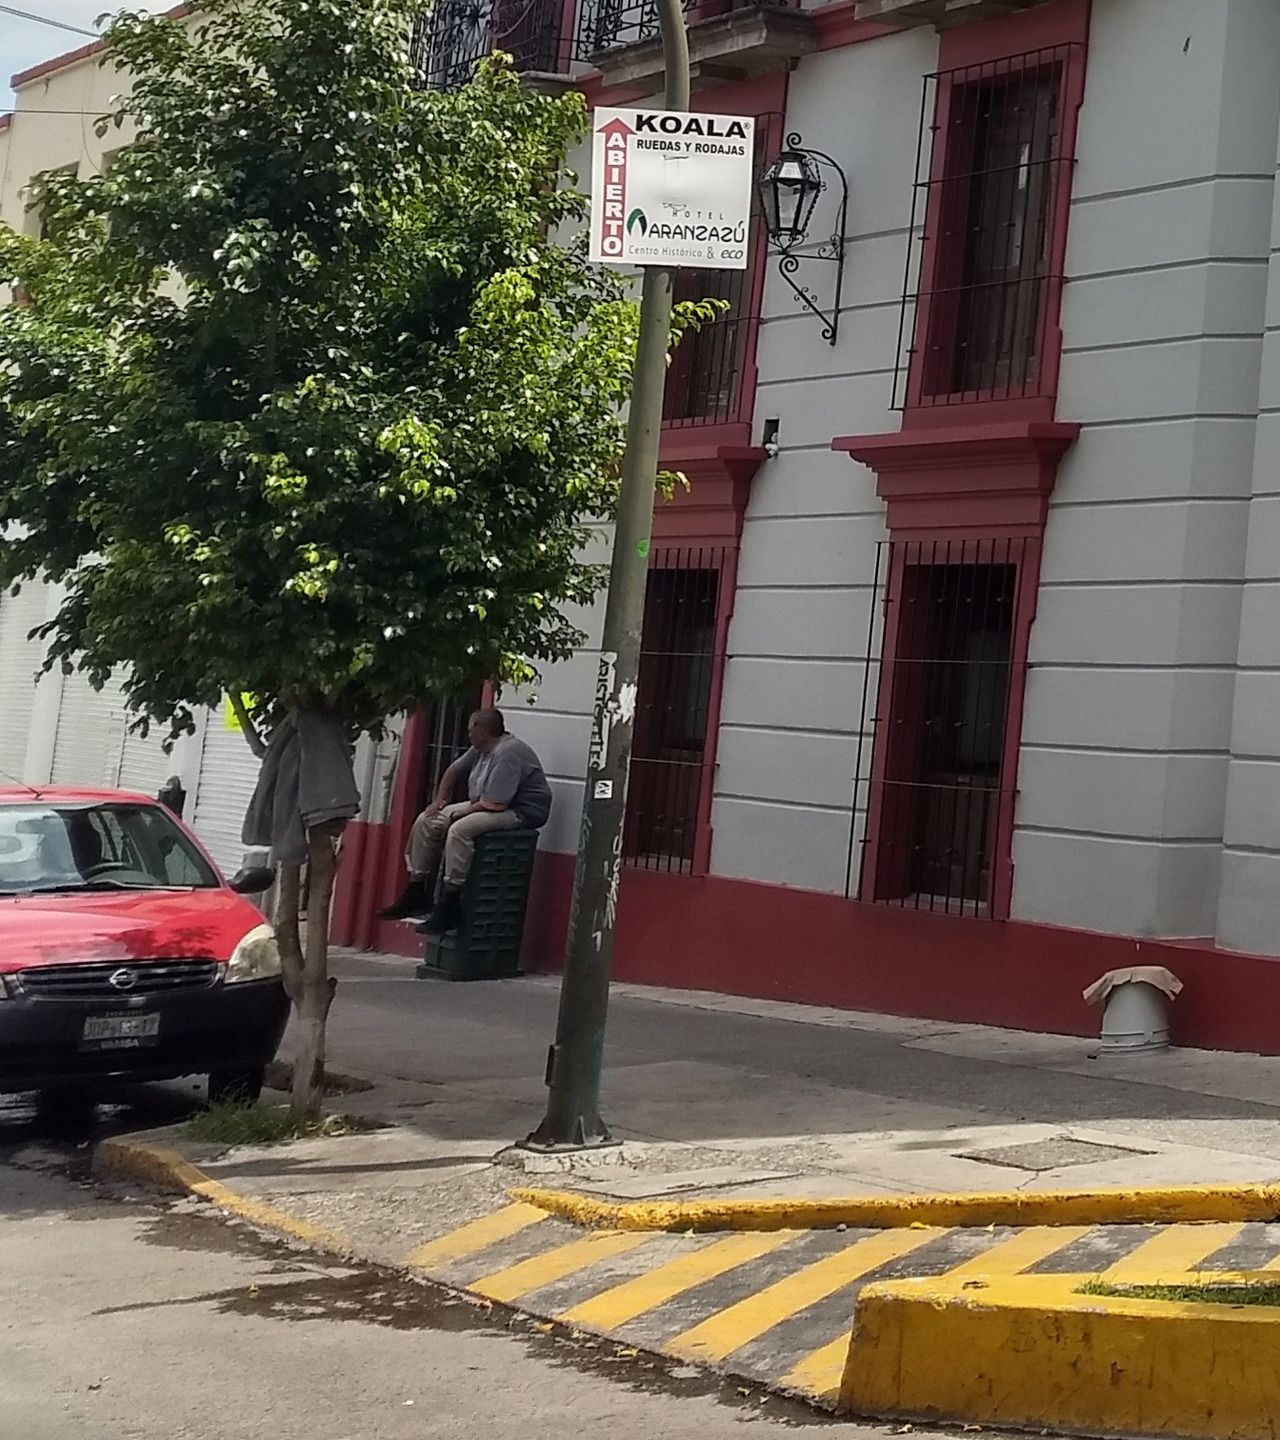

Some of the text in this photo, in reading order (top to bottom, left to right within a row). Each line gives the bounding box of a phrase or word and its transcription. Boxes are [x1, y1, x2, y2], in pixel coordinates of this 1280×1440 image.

[635, 114, 747, 139] KOALA
[636, 139, 745, 156] RUEDAS Y RODAJAS
[602, 132, 626, 255] ABIERTO
[671, 211, 724, 221] HOTEL
[628, 245, 743, 260] Centro Histórico & eco
